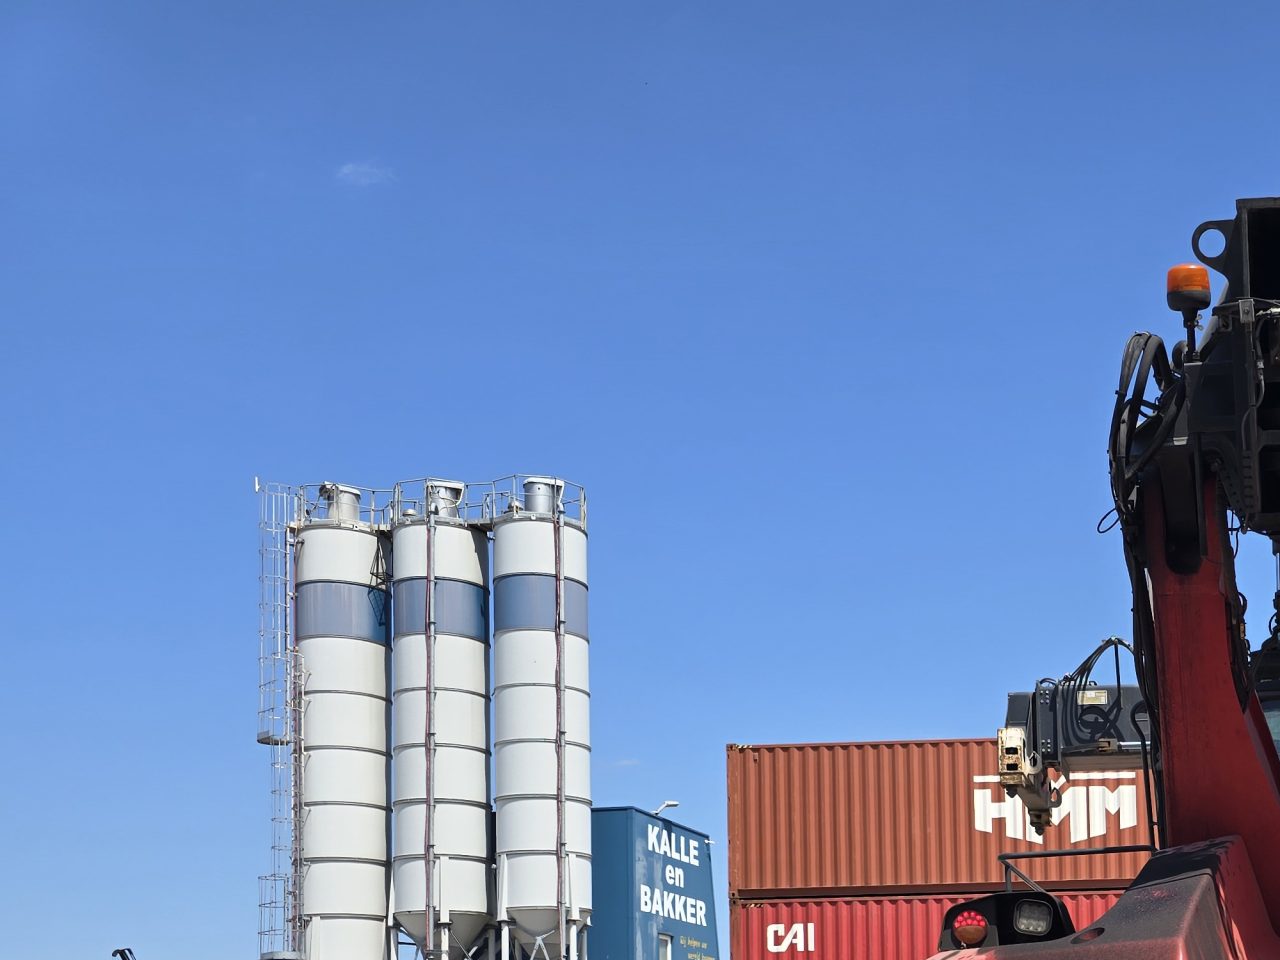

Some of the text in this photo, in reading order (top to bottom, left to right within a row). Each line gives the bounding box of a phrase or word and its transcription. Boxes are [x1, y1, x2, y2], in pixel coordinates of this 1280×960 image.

[973, 785, 1137, 845] HMM
[648, 824, 700, 867] KALLE
[665, 864, 685, 888] en
[640, 884, 708, 927] BAKKER
[766, 922, 815, 953] CAI
